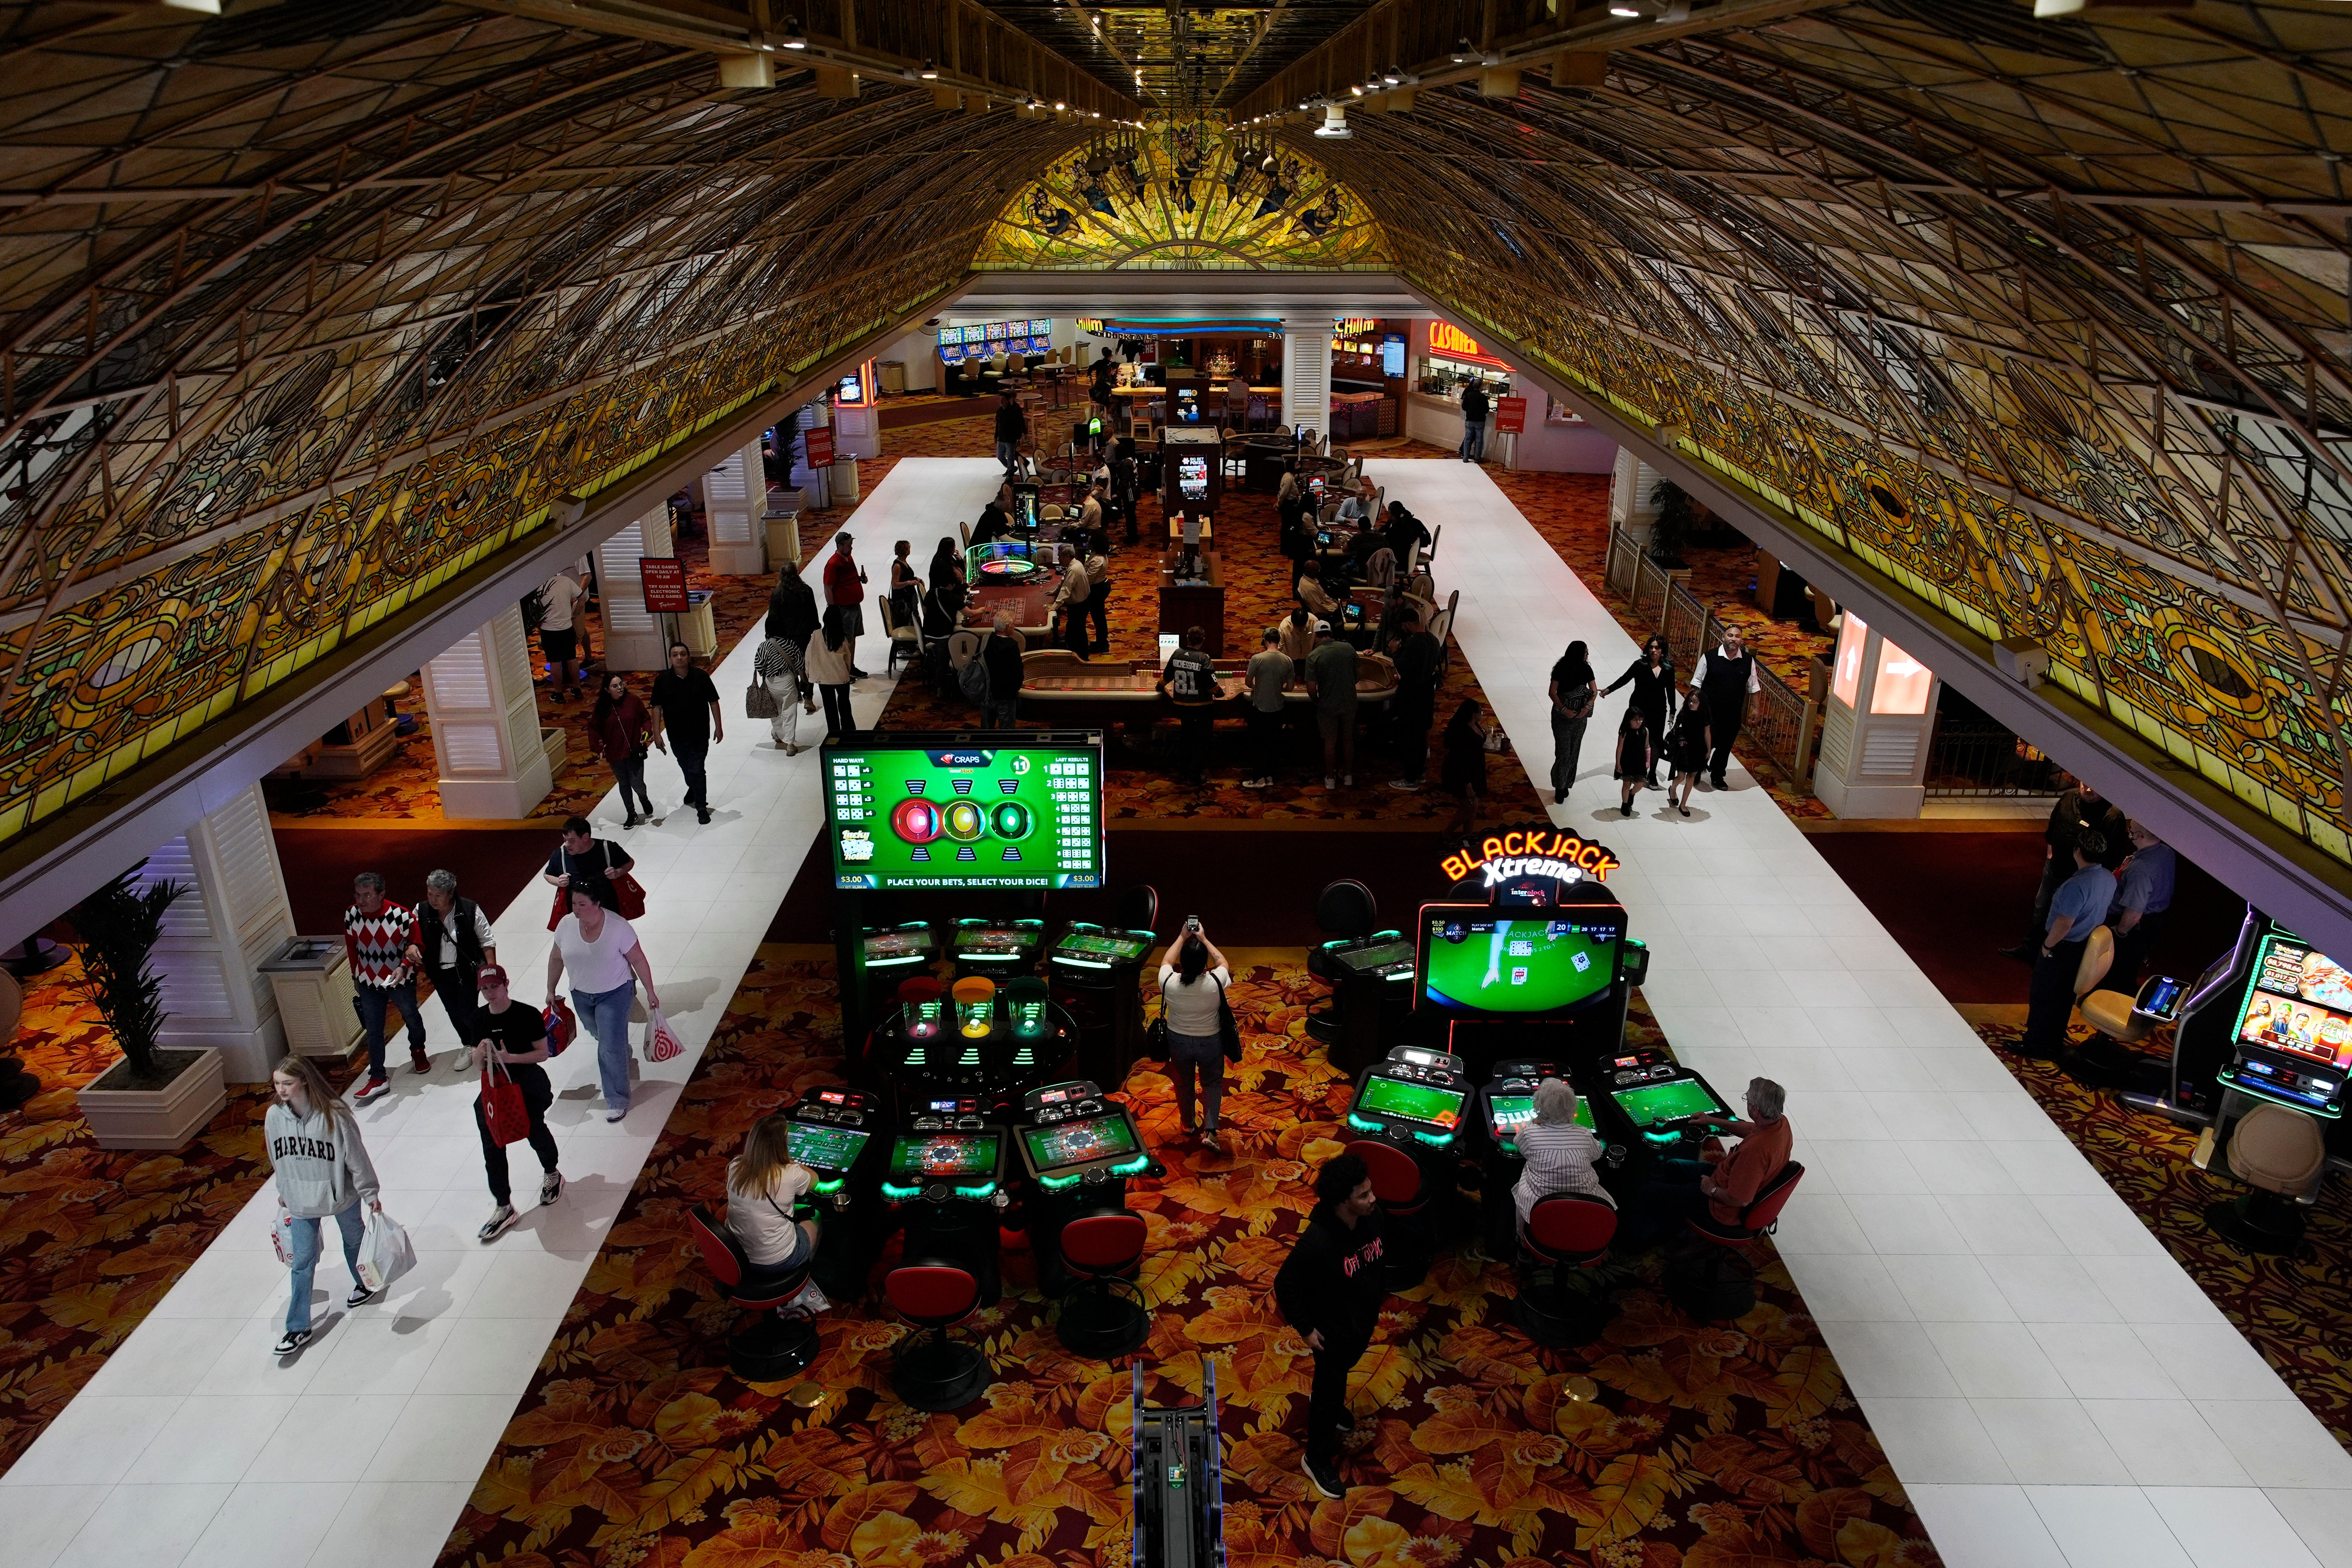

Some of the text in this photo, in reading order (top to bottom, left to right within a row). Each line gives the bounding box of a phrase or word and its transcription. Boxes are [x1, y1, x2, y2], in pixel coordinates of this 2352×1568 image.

[1175, 670, 1199, 695] 81
[1013, 761, 1026, 770] 11
[842, 829, 870, 841] Lucky
[844, 852, 873, 860] Roller
[1441, 831, 1620, 882] BLACKJACK
[1481, 856, 1582, 888] Xtreme
[2321, 1019, 2350, 1030] THREE
[2272, 1088, 2308, 1101] DENOMINATION
[274, 1136, 335, 1161] HARVARD
